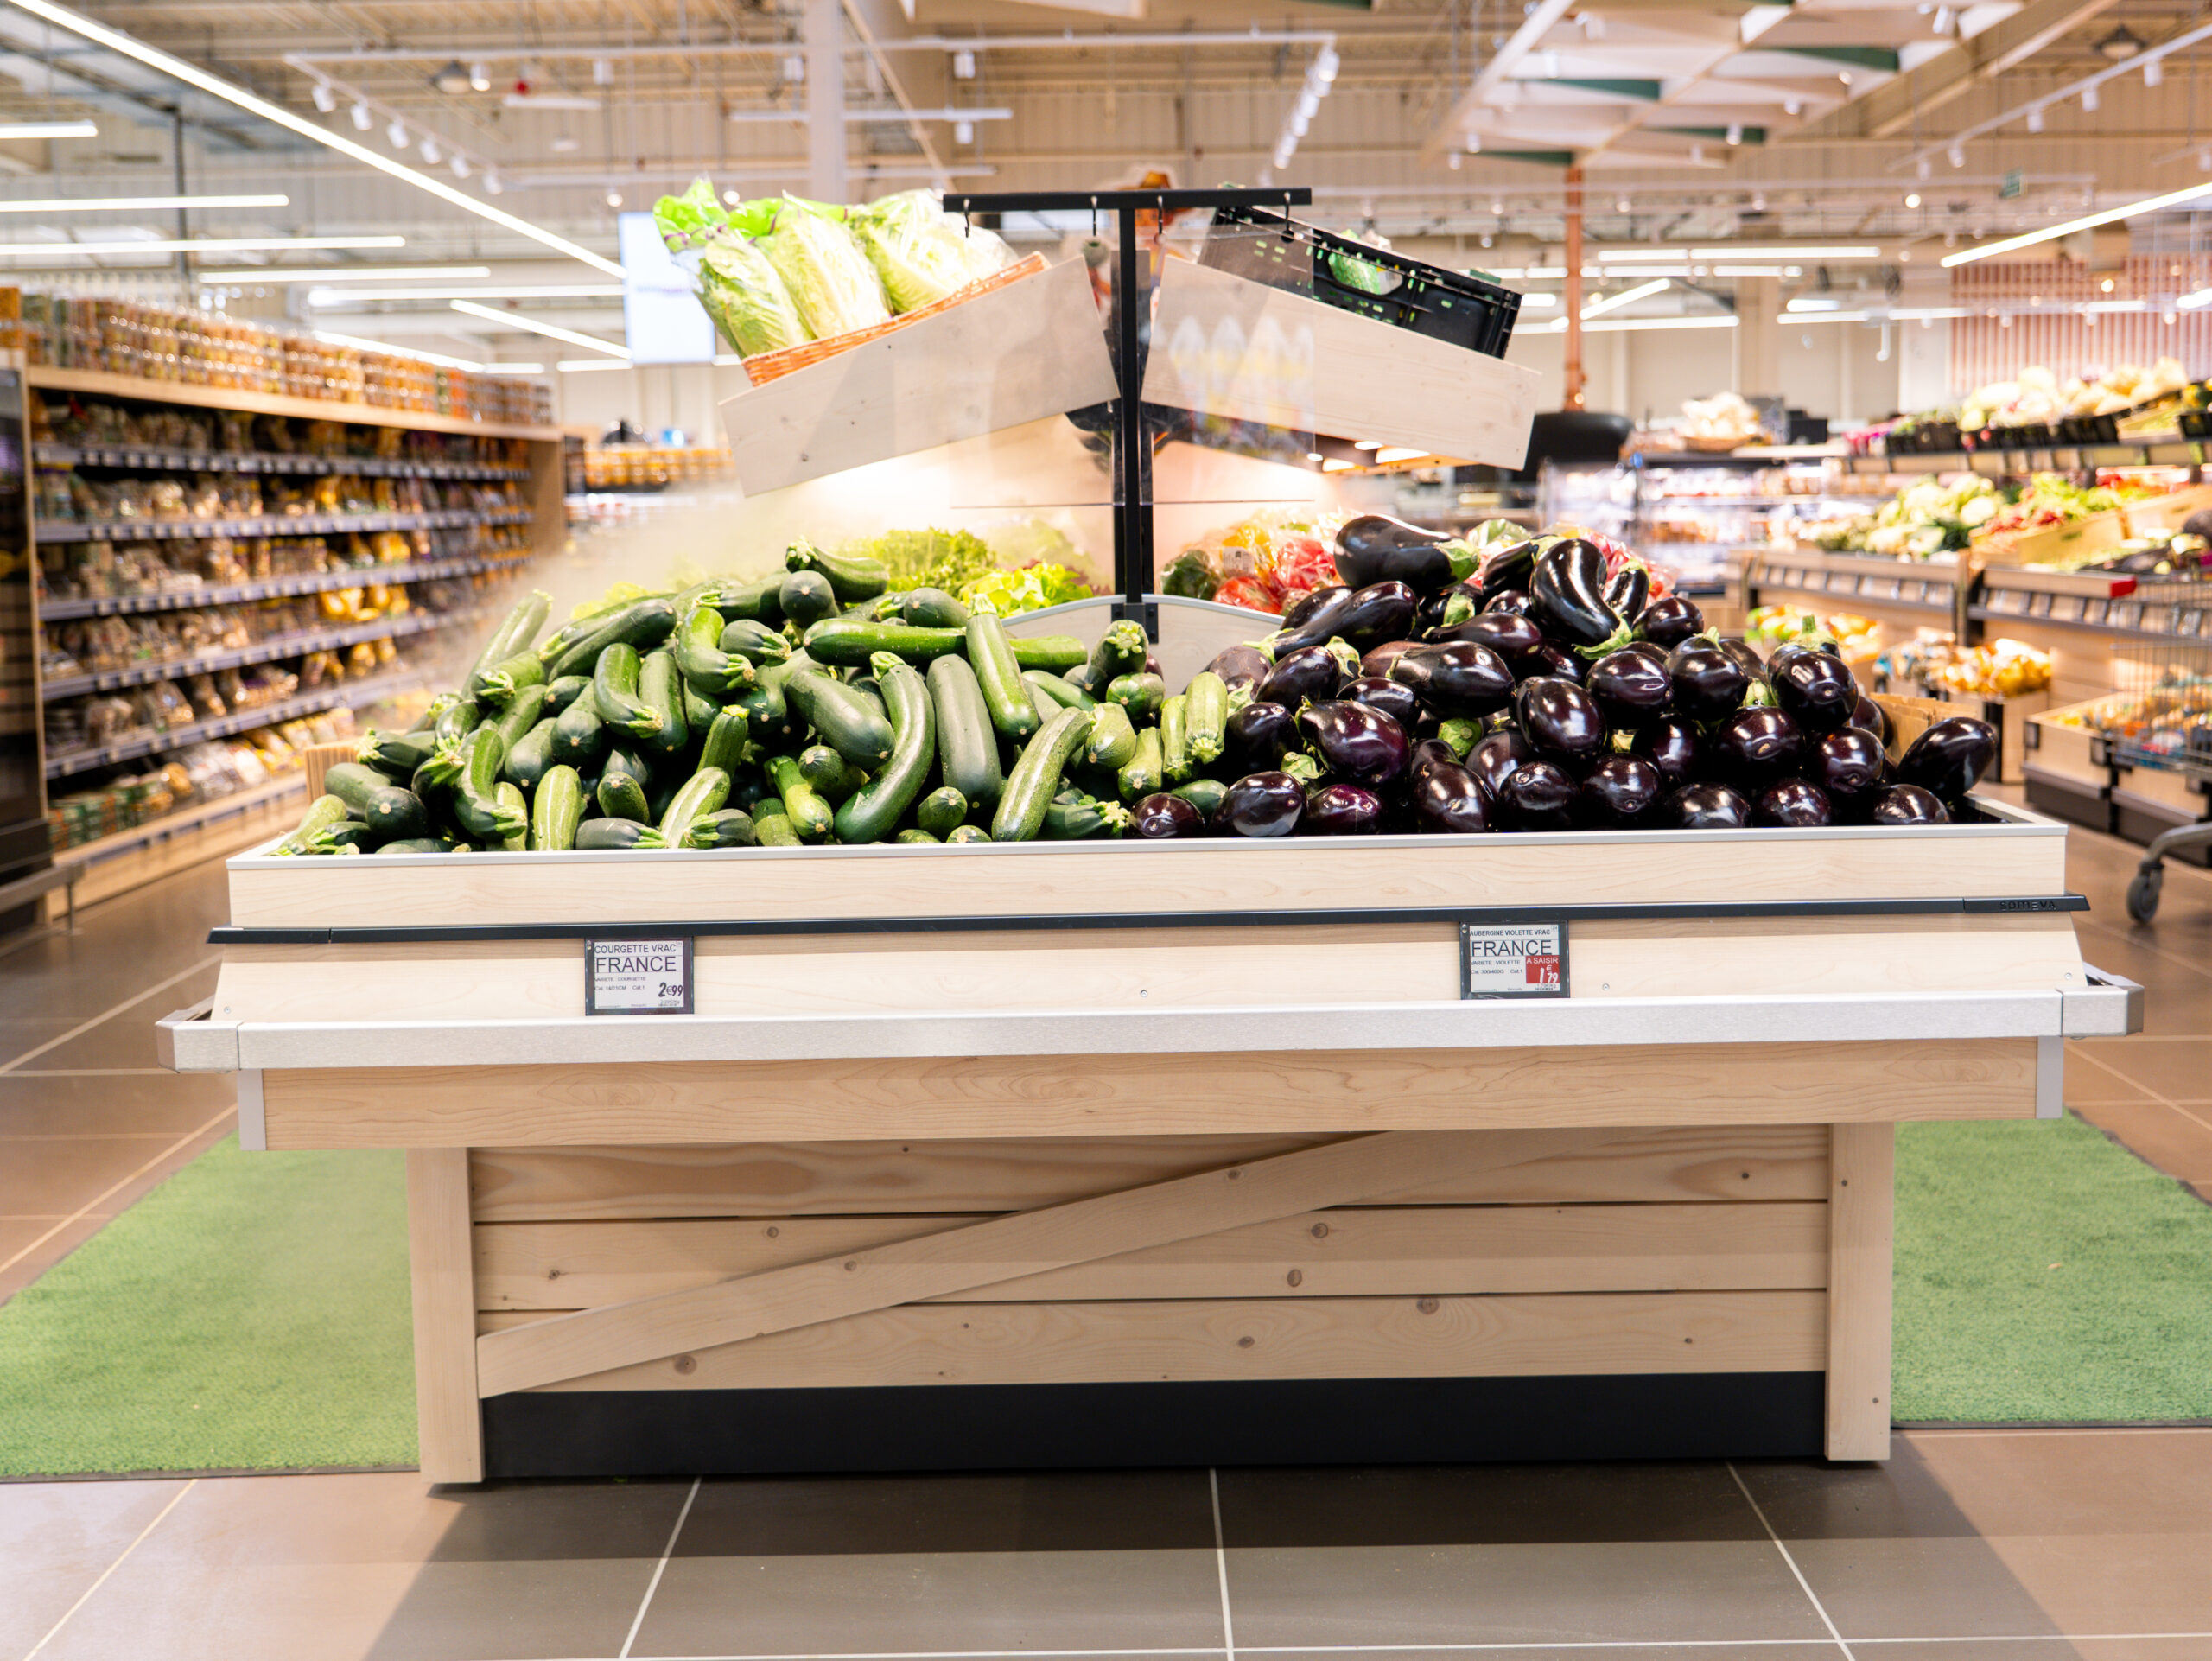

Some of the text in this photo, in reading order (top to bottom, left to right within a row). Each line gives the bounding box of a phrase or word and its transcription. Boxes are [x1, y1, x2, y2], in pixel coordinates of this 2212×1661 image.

[594, 944, 677, 954] COURGETTE VRAC
[1471, 939, 1553, 957] FRANCE
[595, 956, 677, 973] FRANCE
